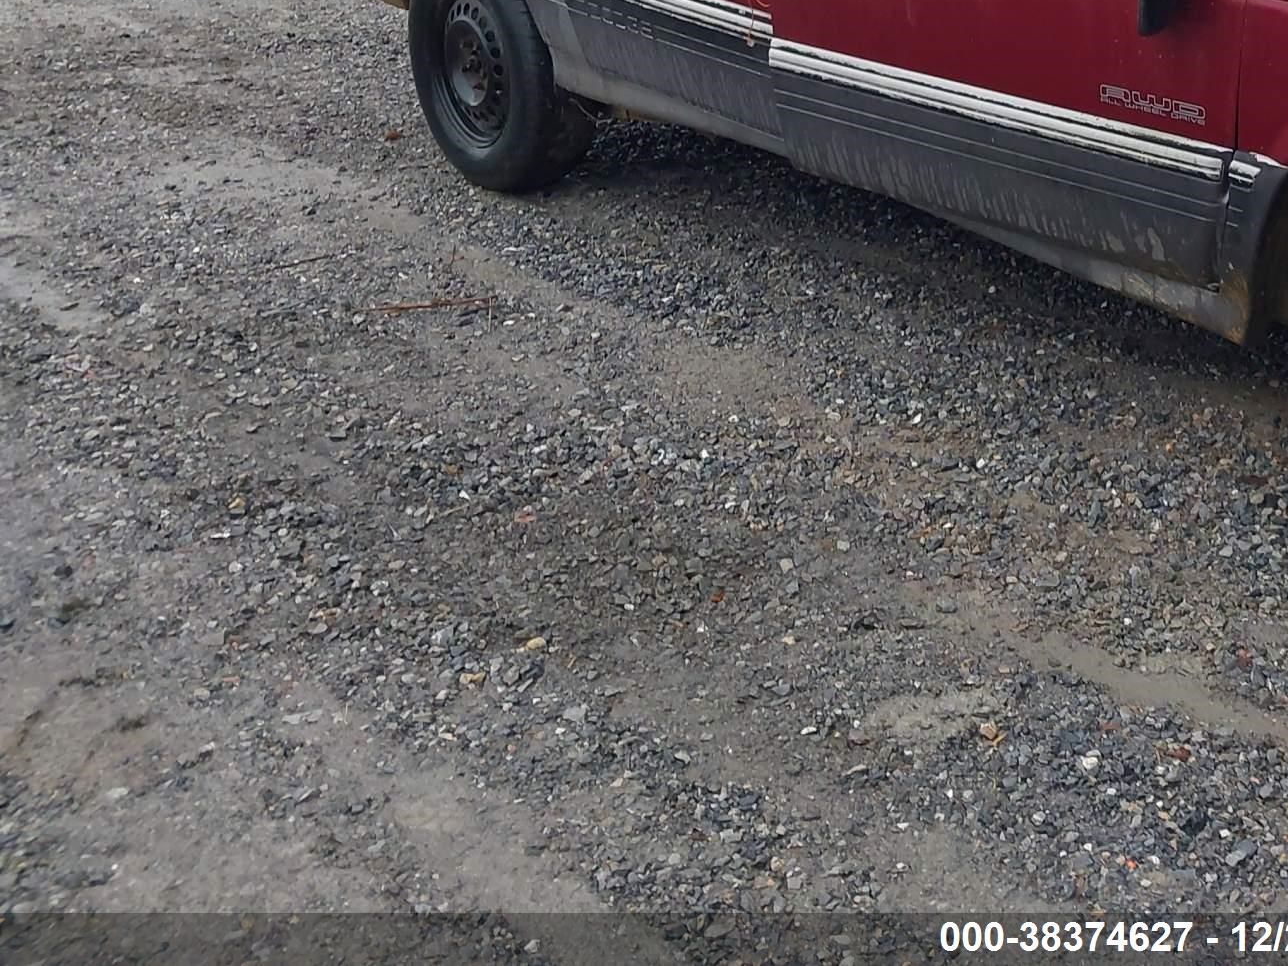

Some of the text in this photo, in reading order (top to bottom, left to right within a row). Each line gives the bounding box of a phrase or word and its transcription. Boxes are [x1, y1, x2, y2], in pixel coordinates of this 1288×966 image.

[1099, 83, 1206, 120] AWD
[1100, 94, 1206, 126] ALL WHEEL DRIVE
